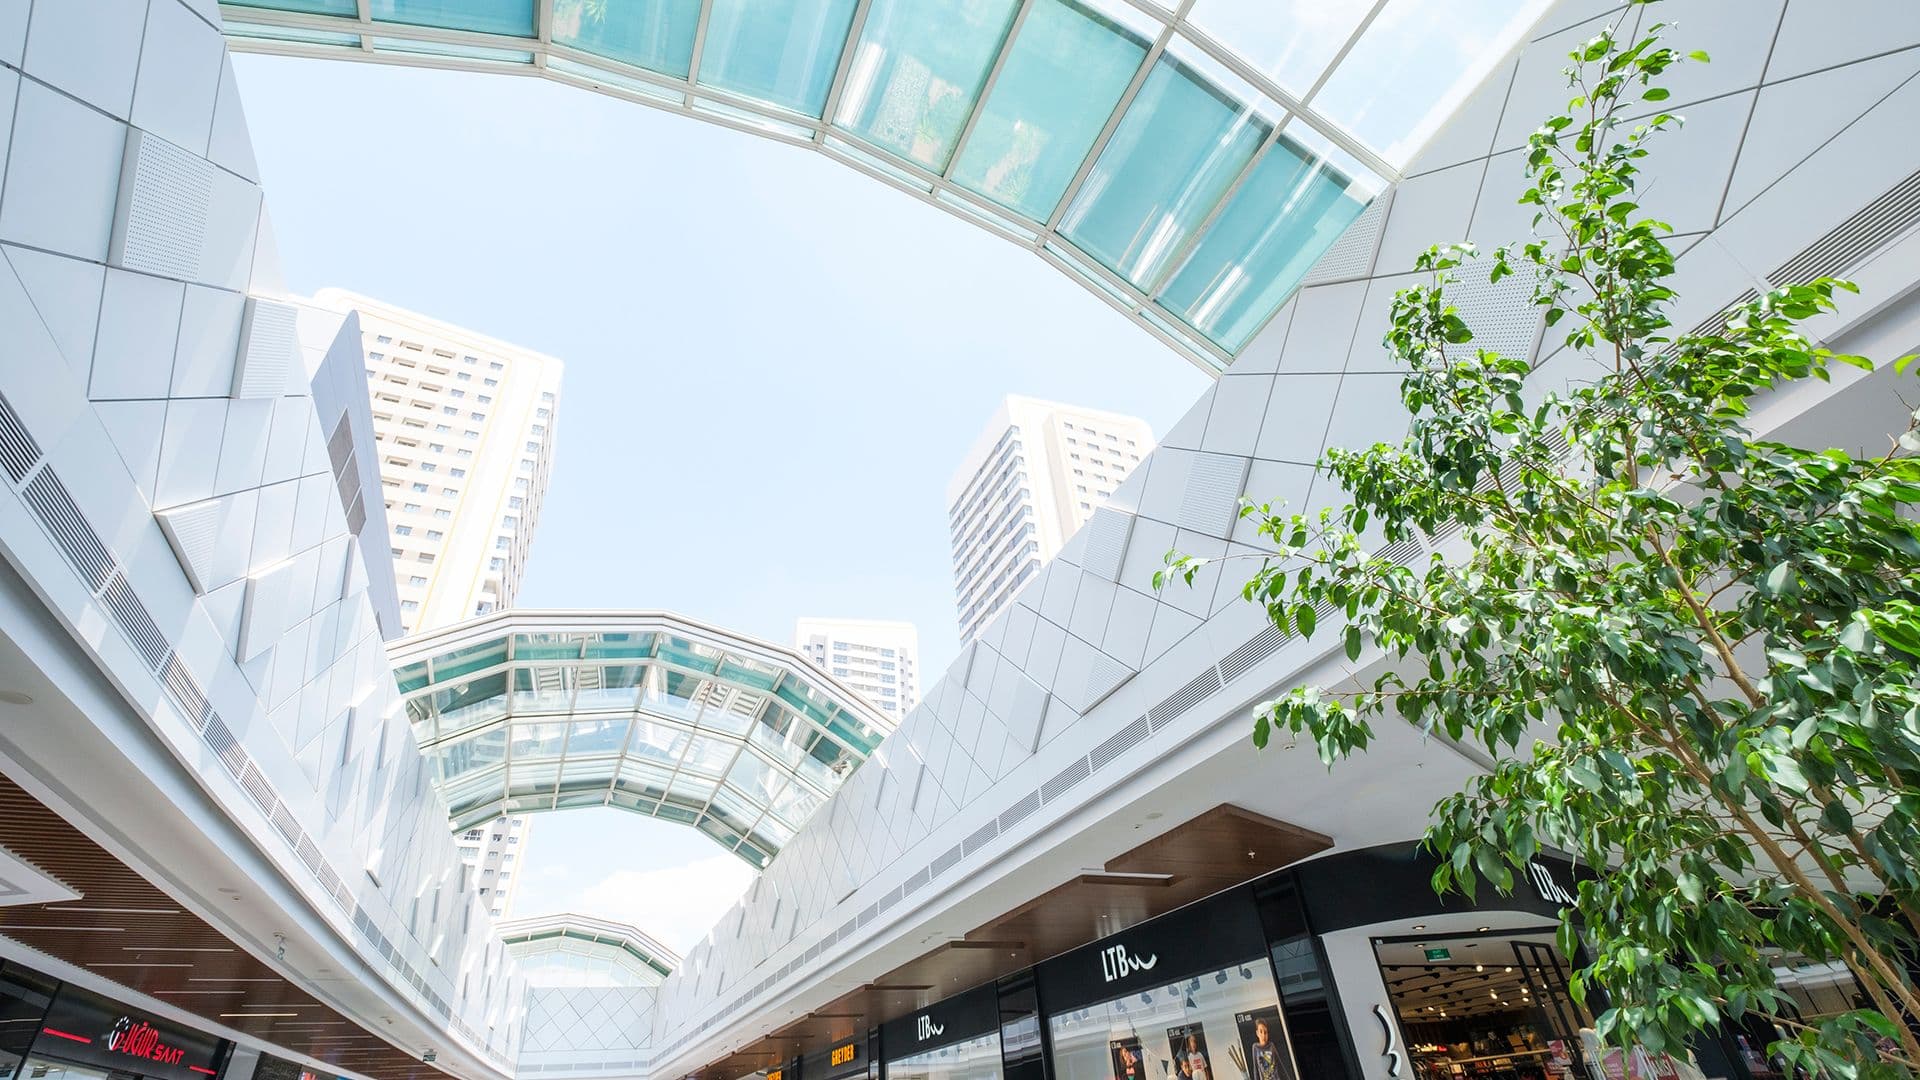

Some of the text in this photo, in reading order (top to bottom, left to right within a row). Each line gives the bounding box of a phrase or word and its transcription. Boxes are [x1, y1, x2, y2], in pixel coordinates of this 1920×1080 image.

[1528, 861, 1562, 904] LTB
[1101, 944, 1130, 982] LTB
[152, 1043, 185, 1065] SAAT
